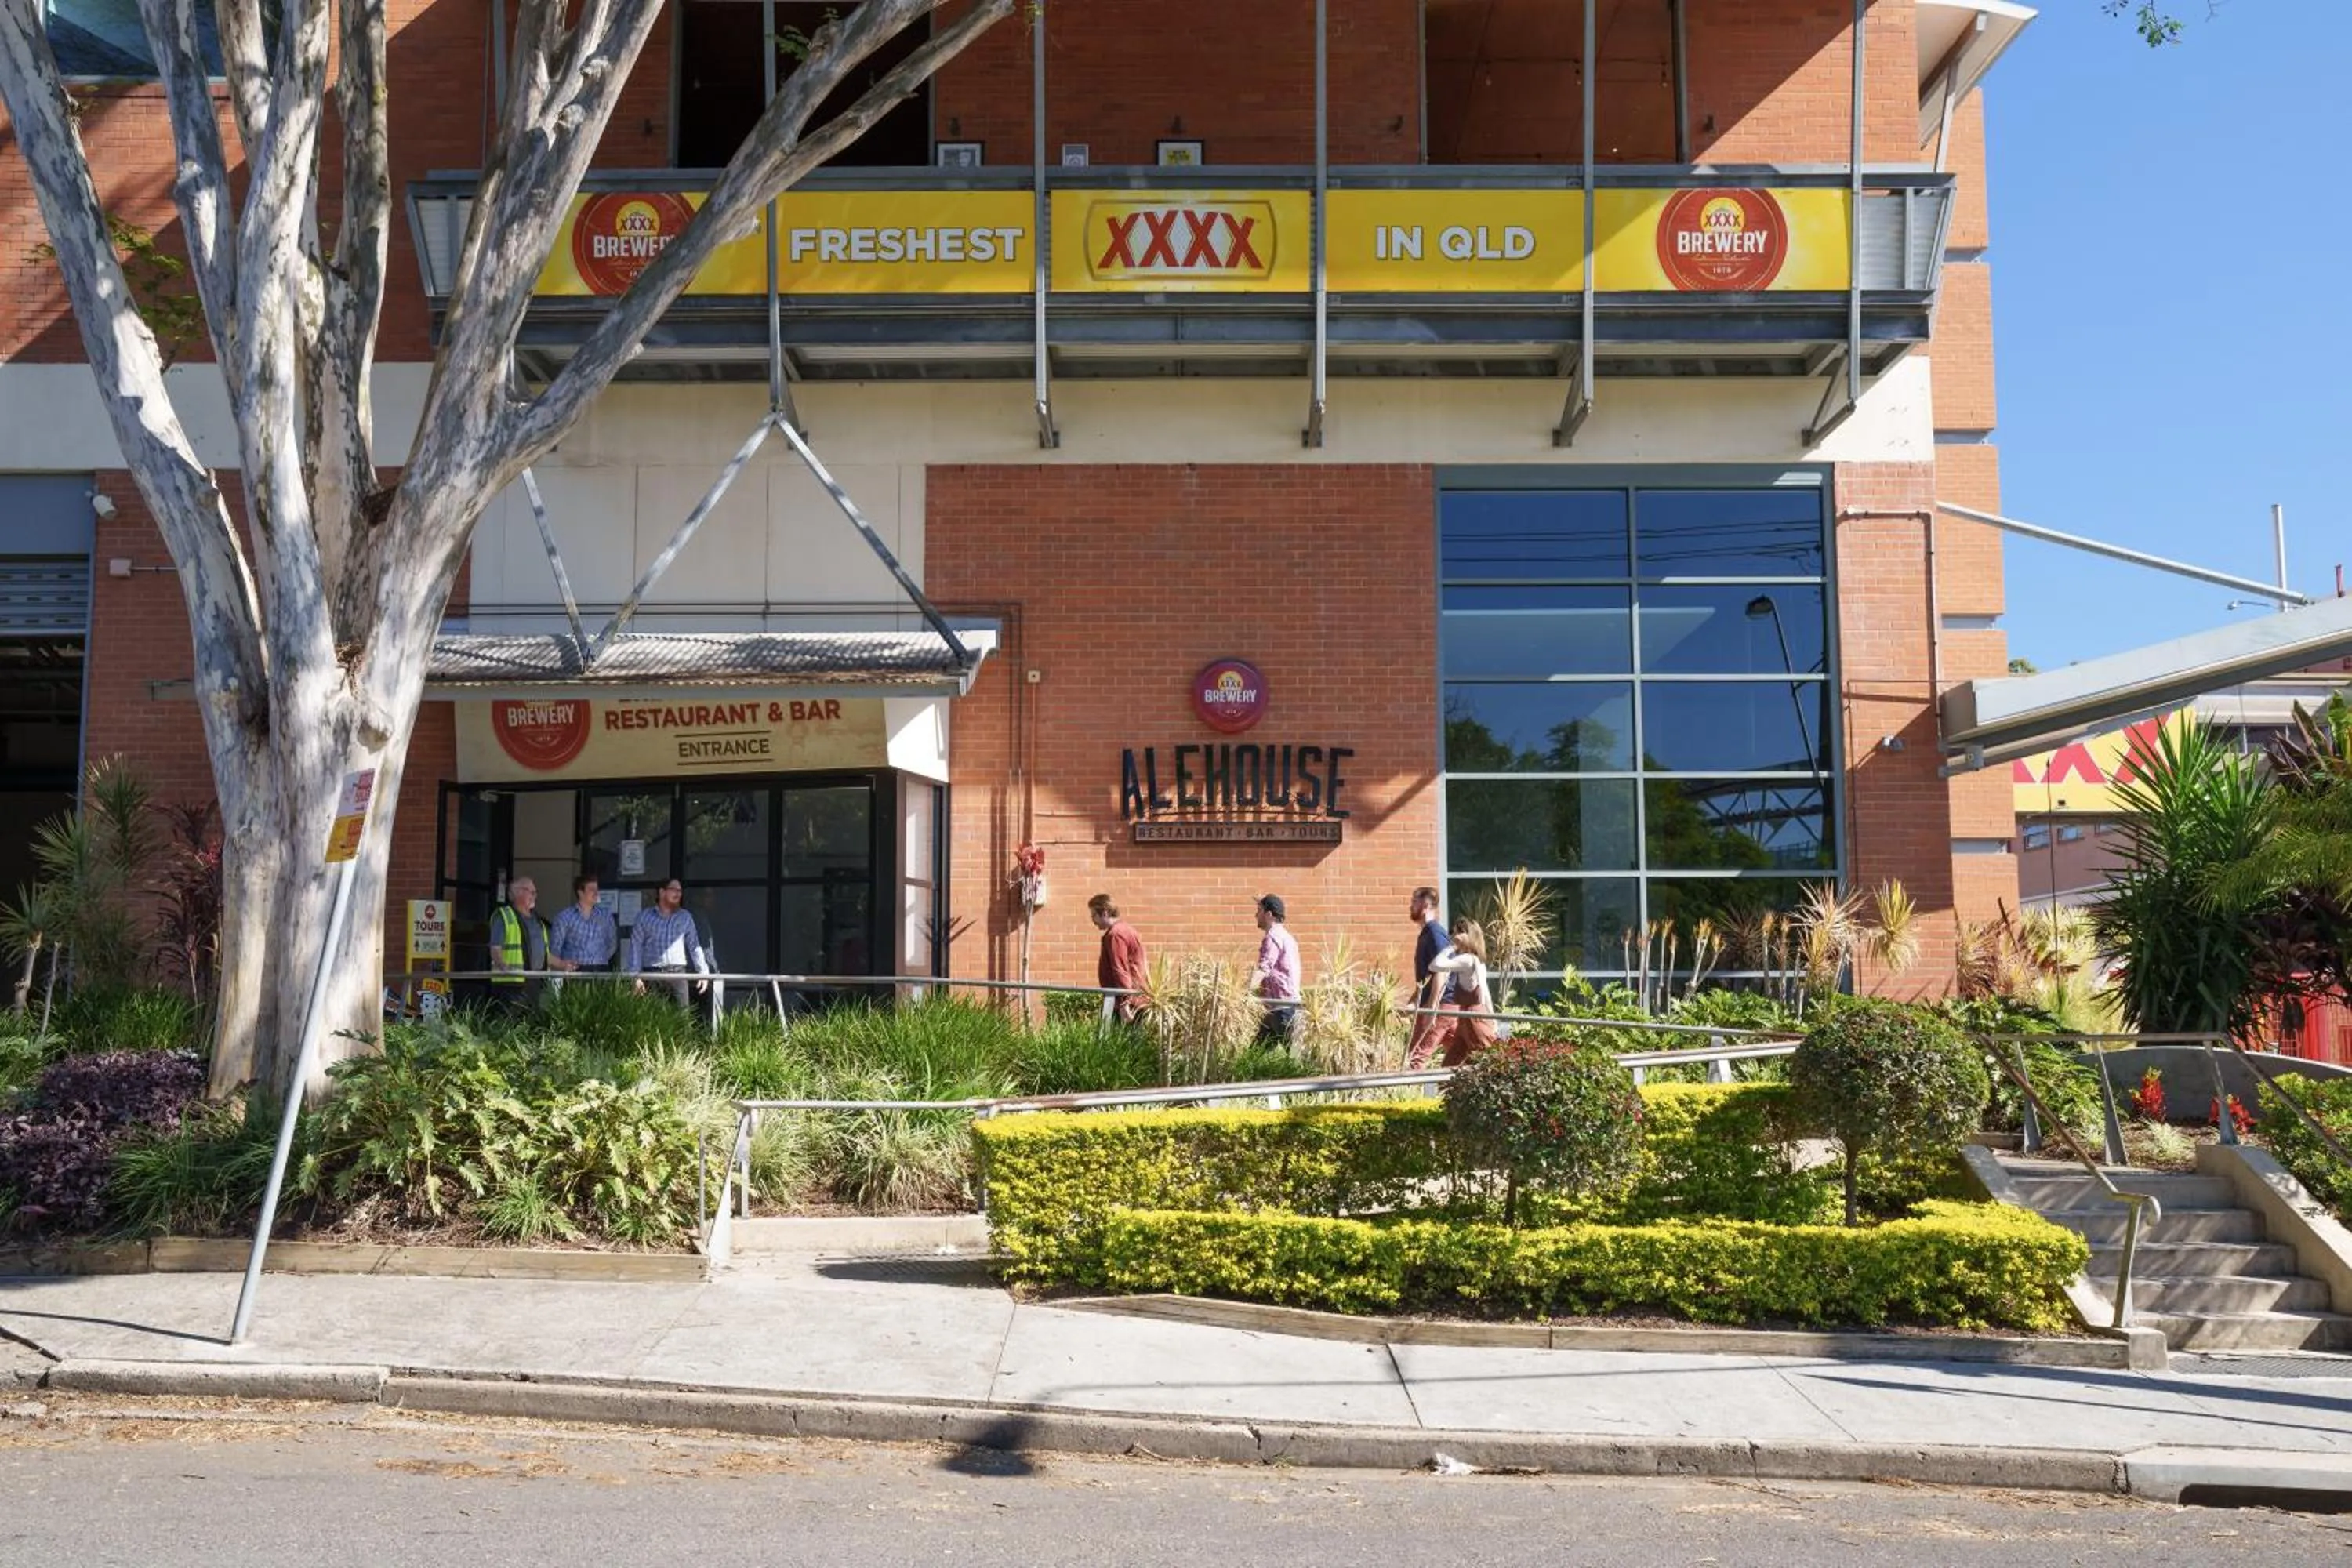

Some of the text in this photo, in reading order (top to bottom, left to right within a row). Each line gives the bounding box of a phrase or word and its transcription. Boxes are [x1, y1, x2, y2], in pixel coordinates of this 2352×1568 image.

[620, 215, 655, 230] XXXX
[1704, 212, 1741, 227] XXXX
[593, 234, 676, 257] BREWE
[790, 227, 1024, 262] FRESHEST
[1098, 209, 1264, 269] XXXX
[1376, 225, 1536, 262] IN QLD
[1677, 230, 1768, 253] BREWERY
[1204, 689, 1257, 703] BREWERY
[507, 704, 575, 727] BREWERY
[604, 699, 841, 730] RESTAURANT & BAR
[679, 739, 770, 757] ENTRANCE
[1120, 744, 1355, 820] ALEHOUSE
[1138, 826, 1338, 838] RESTAURANT BAR TOURS
[414, 920, 445, 931] TOURS
